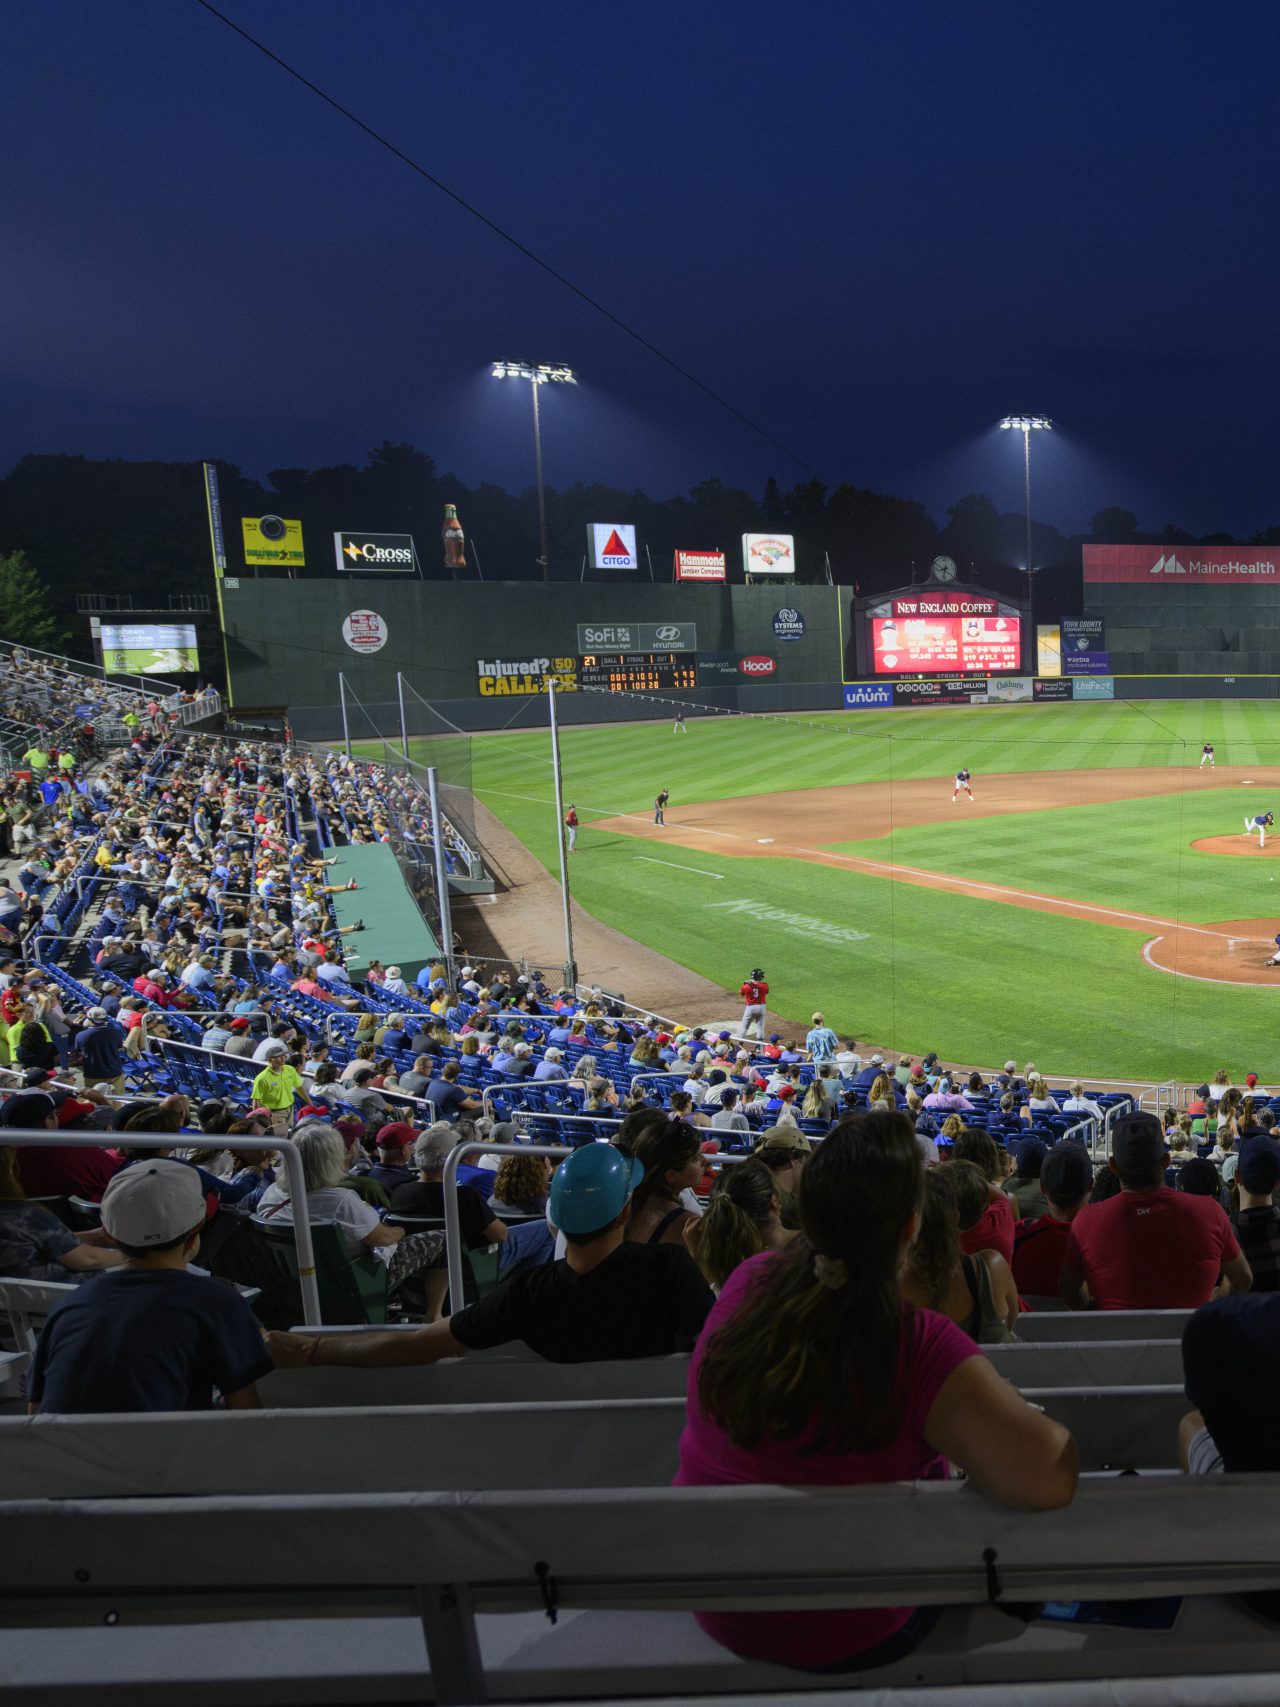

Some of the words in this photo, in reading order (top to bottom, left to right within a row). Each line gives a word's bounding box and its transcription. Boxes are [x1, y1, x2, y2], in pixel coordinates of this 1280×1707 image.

[362, 543, 412, 560] CROSS
[602, 557, 631, 566] CITGO
[679, 553, 725, 567] Hammond
[680, 567, 700, 575] Lumber
[701, 567, 725, 578] Company
[1189, 561, 1275, 574] MaineHealth
[897, 603, 917, 614] NEW
[919, 602, 959, 613] ENGLAND
[960, 602, 993, 612] COFFEE
[1063, 620, 1079, 628] YORK
[1079, 620, 1103, 628] COUNTY
[584, 628, 615, 643] SoFi
[584, 656, 596, 666] 27
[743, 660, 773, 672] Hood
[478, 658, 550, 679] Injured?
[479, 675, 541, 696] CALL
[543, 674, 577, 694] JOE
[1076, 681, 1110, 691] UniFirst
[847, 688, 888, 703] unum
[753, 988, 759, 998] 3
